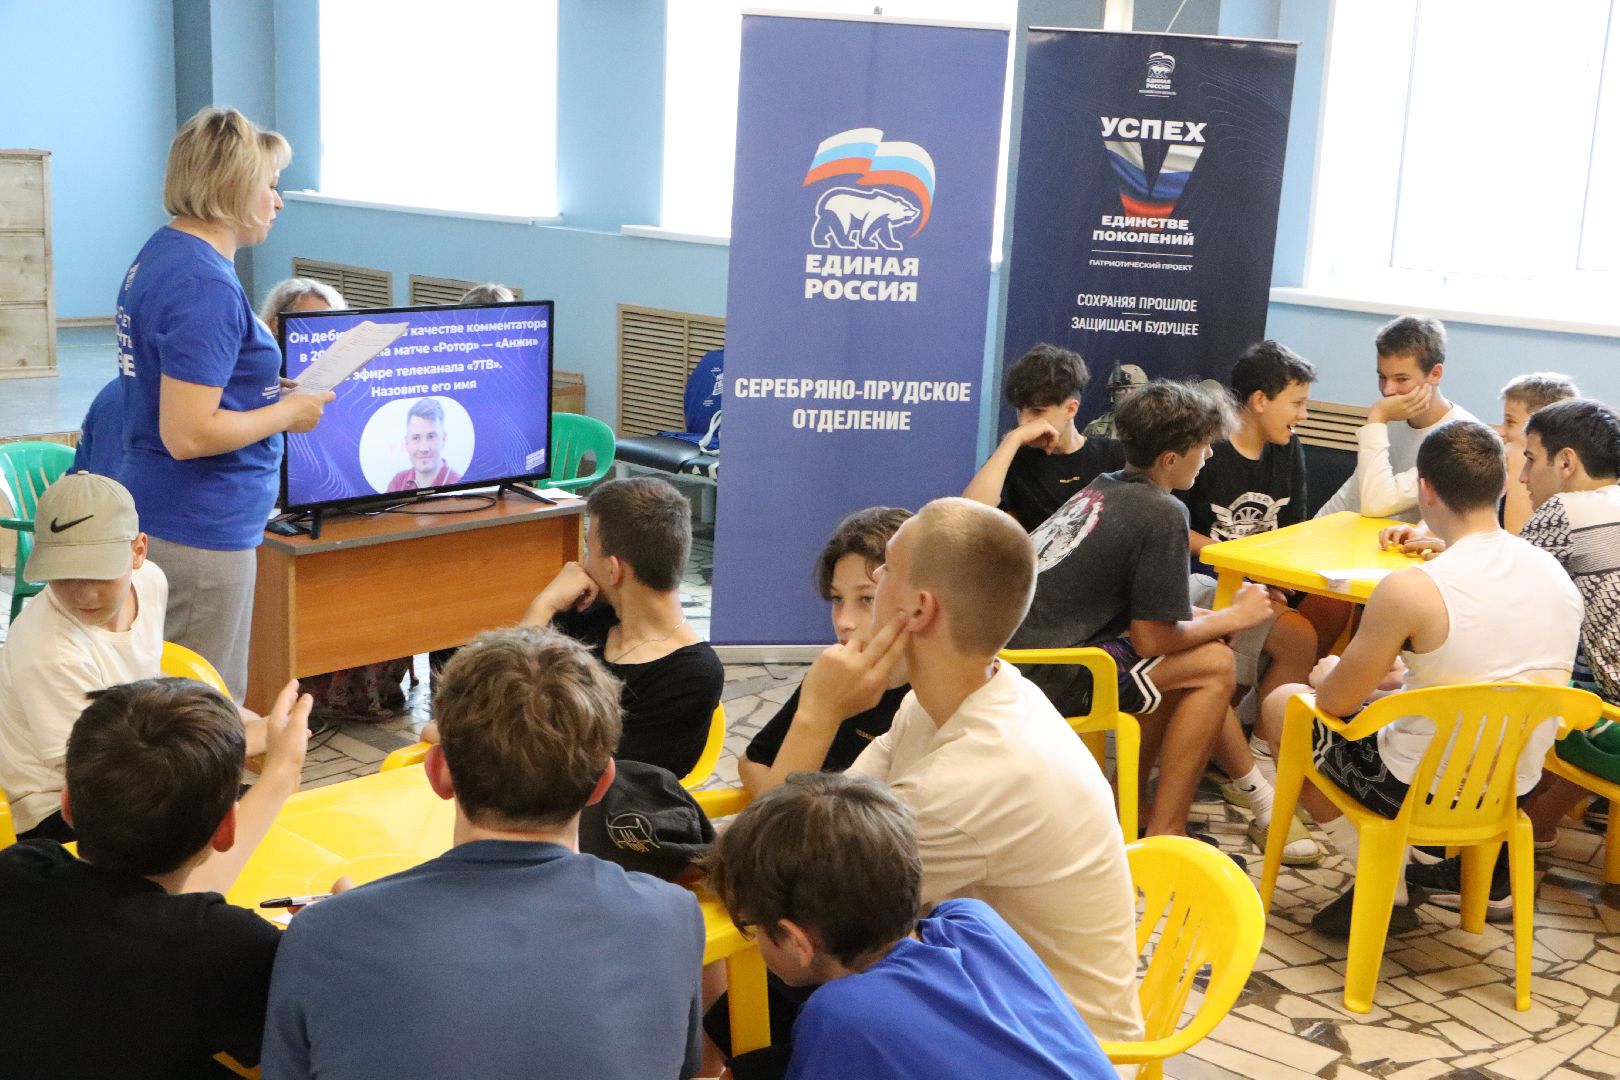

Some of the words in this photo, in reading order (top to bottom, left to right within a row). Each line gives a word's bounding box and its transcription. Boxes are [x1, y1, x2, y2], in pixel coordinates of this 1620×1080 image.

[1100, 116, 1208, 143] УСПЕХ
[1101, 215, 1190, 231] ЕДИНСТВЕ
[1092, 230, 1195, 246] ПОКОЛЕНИЙ
[805, 253, 920, 277] ЕДИНАЯ
[1089, 259, 1161, 270] ПАТРИОТИЧЕСКИЙ
[1162, 263, 1193, 271] ПРОЕКТ
[804, 278, 918, 302] РОССИЯ
[1076, 293, 1137, 309] СОХРАНЯЯ
[1138, 297, 1199, 312] ПРОШЛОЕ
[289, 331, 309, 344] Он
[410, 324, 464, 336] качестве
[466, 319, 548, 333] комментатора
[1071, 316, 1142, 333] ЗАЩИЩАЕМ
[1144, 320, 1200, 336] БУДУЩЕЕ
[299, 353, 308, 363] в
[394, 344, 431, 356] матче
[432, 341, 480, 354] «Ротор»
[494, 337, 539, 349] «Анжи»
[352, 367, 394, 382] эфире
[395, 362, 465, 376] телеканала
[466, 359, 503, 371] «7ТВ».
[370, 384, 430, 398] Назовите
[431, 382, 452, 395] его
[453, 379, 478, 391] имя
[734, 377, 972, 404] СЕРЕБРЯНО-ПРУДСКОЕ
[792, 408, 912, 433] ОТДЕЛЕНИЕ
